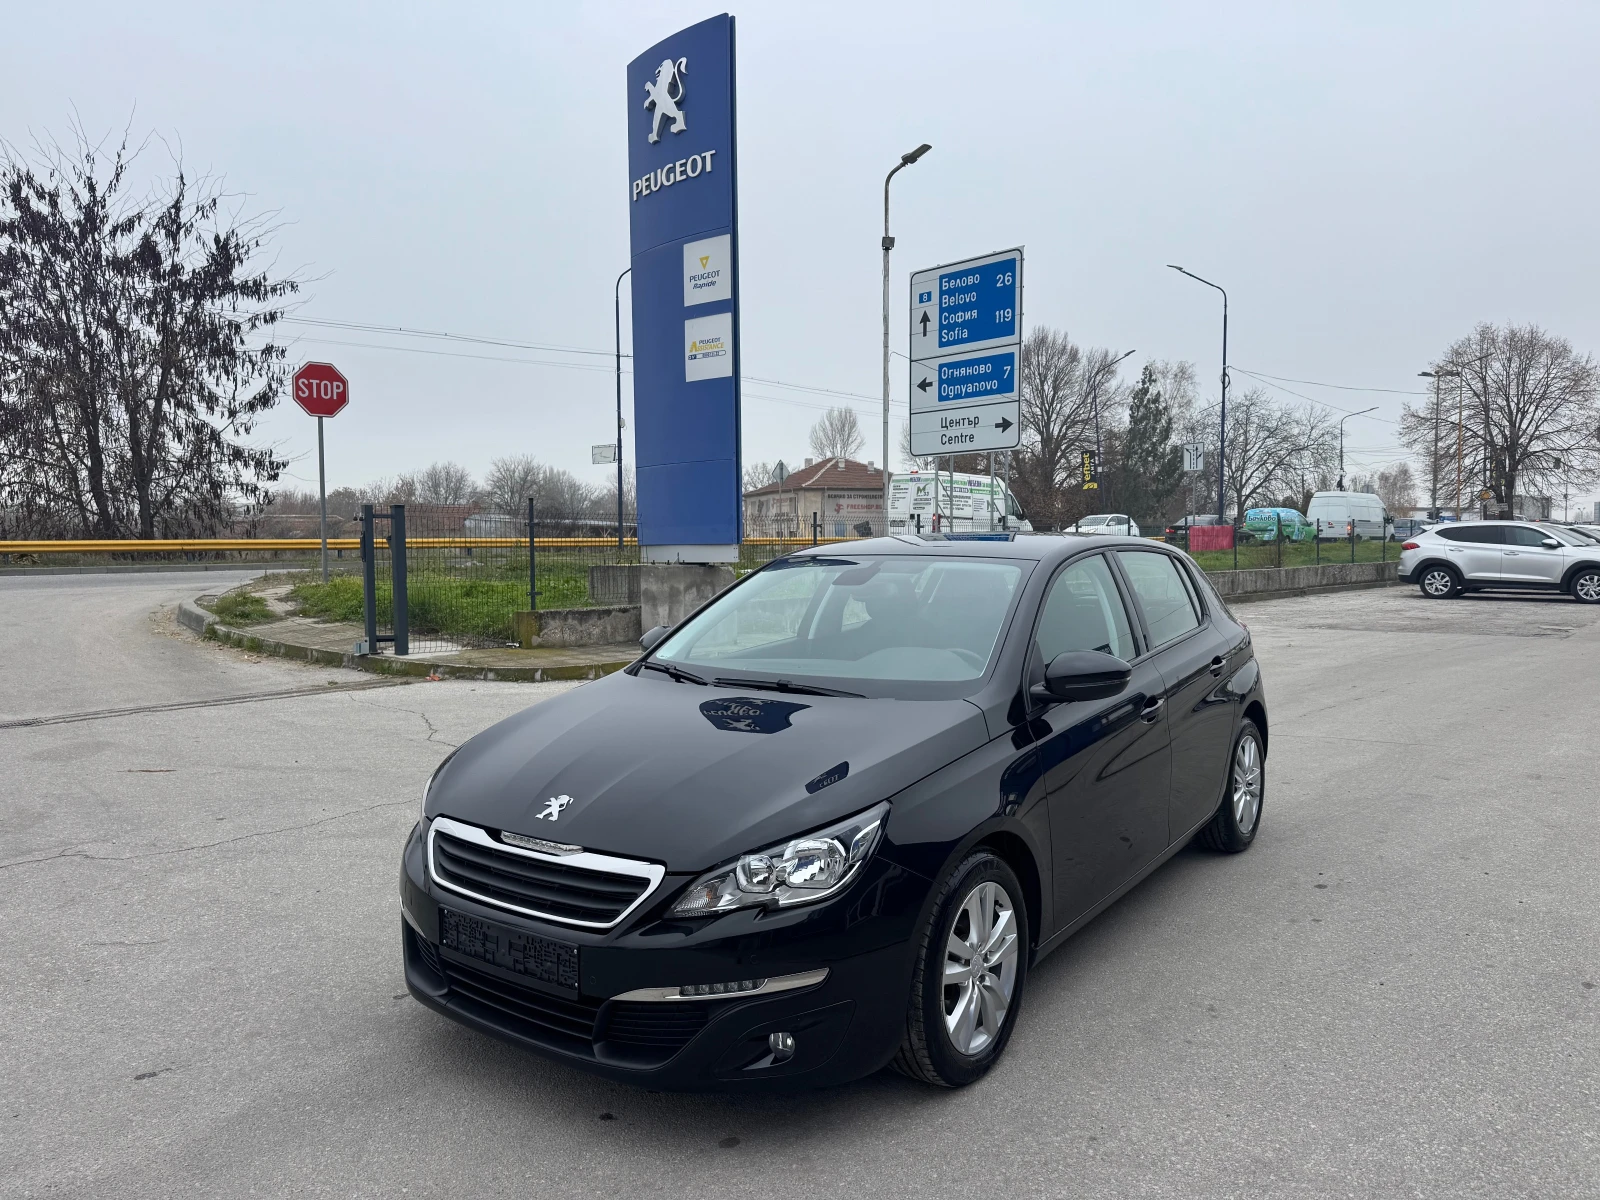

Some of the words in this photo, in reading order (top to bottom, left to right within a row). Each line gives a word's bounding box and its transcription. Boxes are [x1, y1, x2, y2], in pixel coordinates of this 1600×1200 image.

[633, 149, 716, 201] PEUGEOT
[689, 270, 720, 282] PEUGEOT
[942, 274, 980, 290] Белово
[996, 272, 1013, 287] 26
[692, 280, 717, 290] Rapide
[922, 293, 928, 302] 8
[942, 292, 977, 308] Belovo
[942, 309, 978, 325] София
[995, 308, 1012, 323] 119
[698, 337, 722, 345] PEUGEOT
[941, 327, 968, 342] Sofia
[689, 341, 725, 353] ASSISTANCE
[941, 363, 992, 379] Огняново
[1003, 366, 1012, 379] 7
[298, 378, 344, 400] STOP
[941, 380, 998, 398] Ognyanovo
[940, 416, 980, 430] Център
[940, 432, 975, 445] Centre
[1082, 452, 1091, 481] efbet
